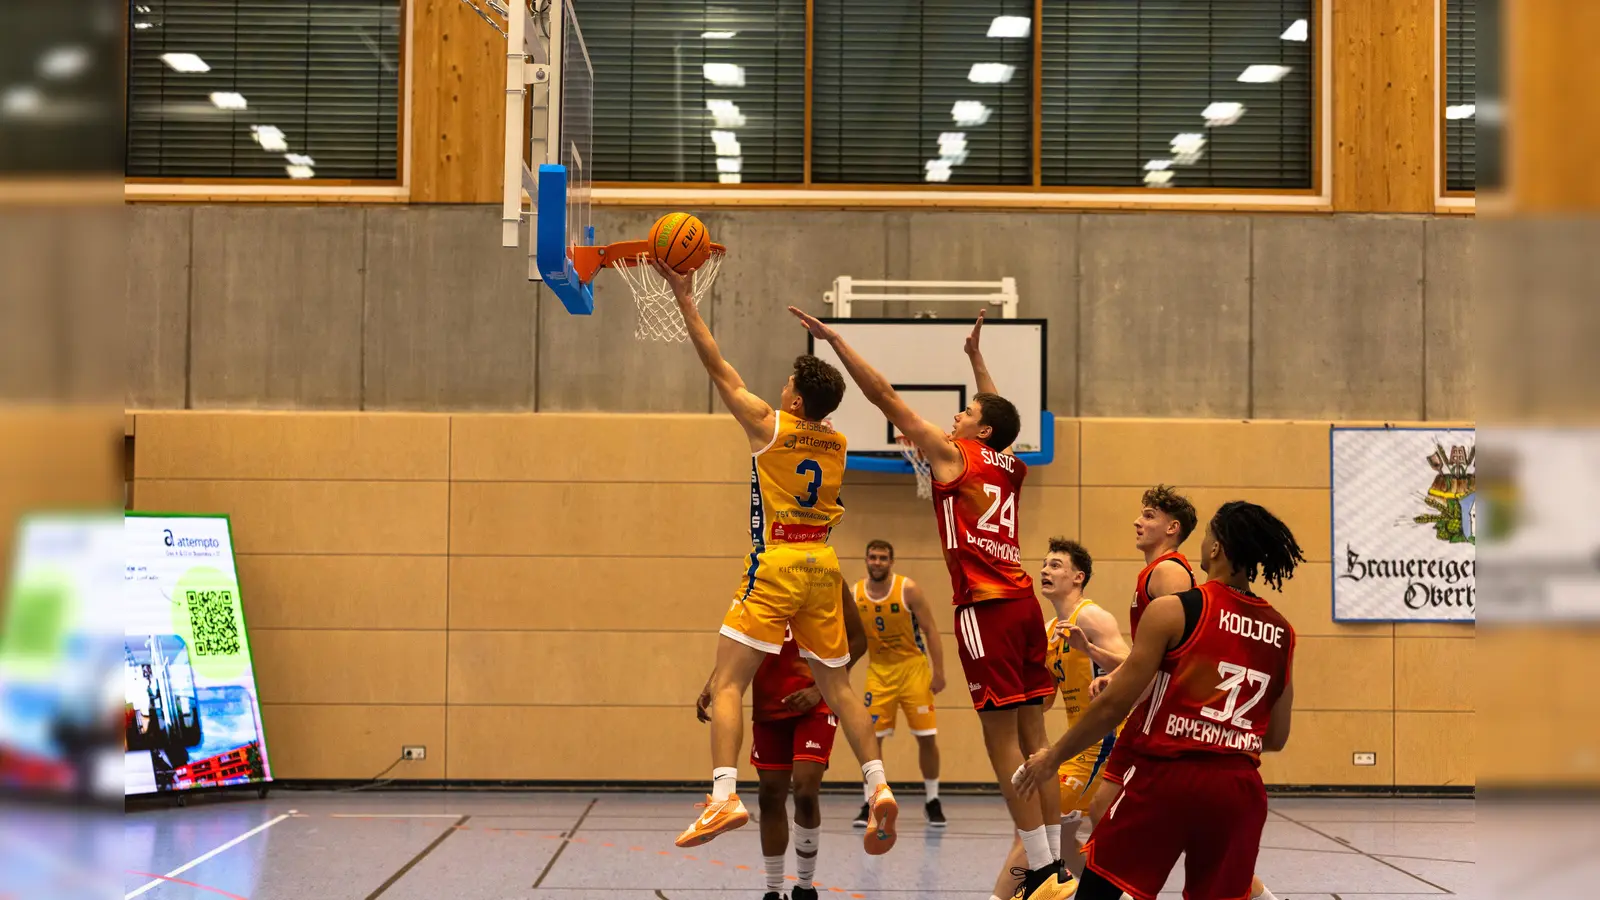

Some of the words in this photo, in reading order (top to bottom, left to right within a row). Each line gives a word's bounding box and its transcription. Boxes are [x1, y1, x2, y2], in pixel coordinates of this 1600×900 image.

[799, 435, 842, 451] attempto
[795, 458, 823, 508] 3
[977, 484, 1015, 538] 24
[177, 537, 219, 549] attempto
[875, 616, 886, 632] 9
[1218, 608, 1285, 649] KODJOE
[863, 691, 873, 708] 9
[1200, 660, 1272, 730] 32
[1164, 713, 1224, 747] BAYERN
